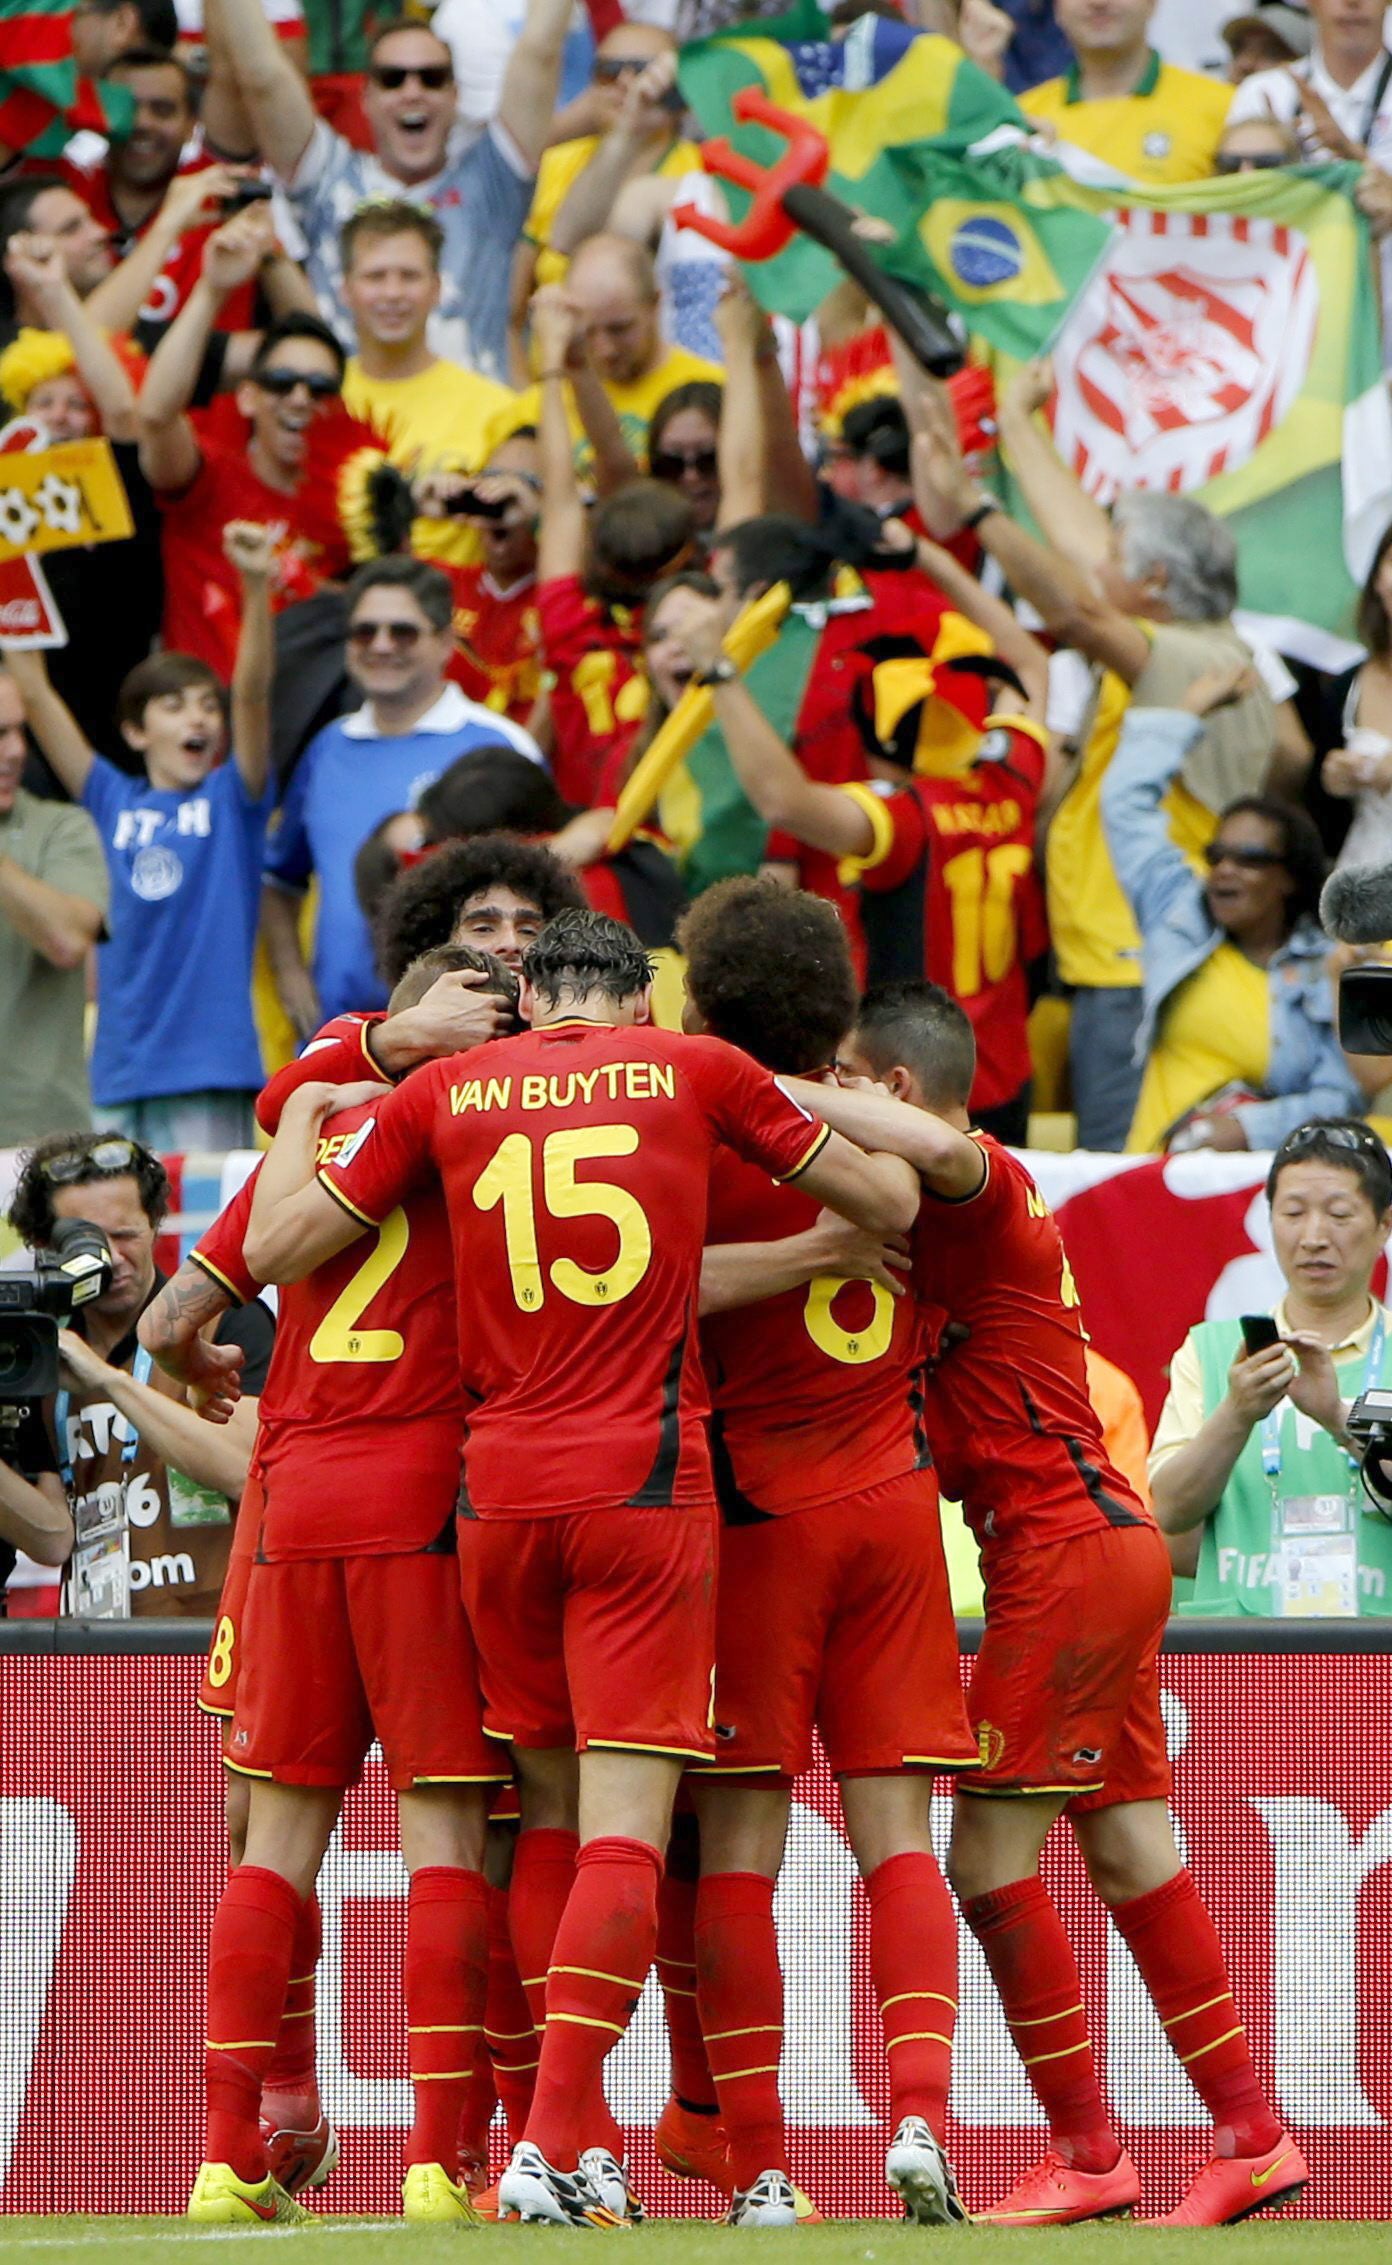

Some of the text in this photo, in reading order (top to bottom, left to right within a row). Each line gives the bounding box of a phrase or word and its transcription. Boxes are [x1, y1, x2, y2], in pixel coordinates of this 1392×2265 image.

[450, 1061, 675, 1116] VAN BUYTEN
[472, 1124, 652, 1313] 15
[310, 1205, 409, 1363] 2
[209, 1615, 235, 1688] 8
